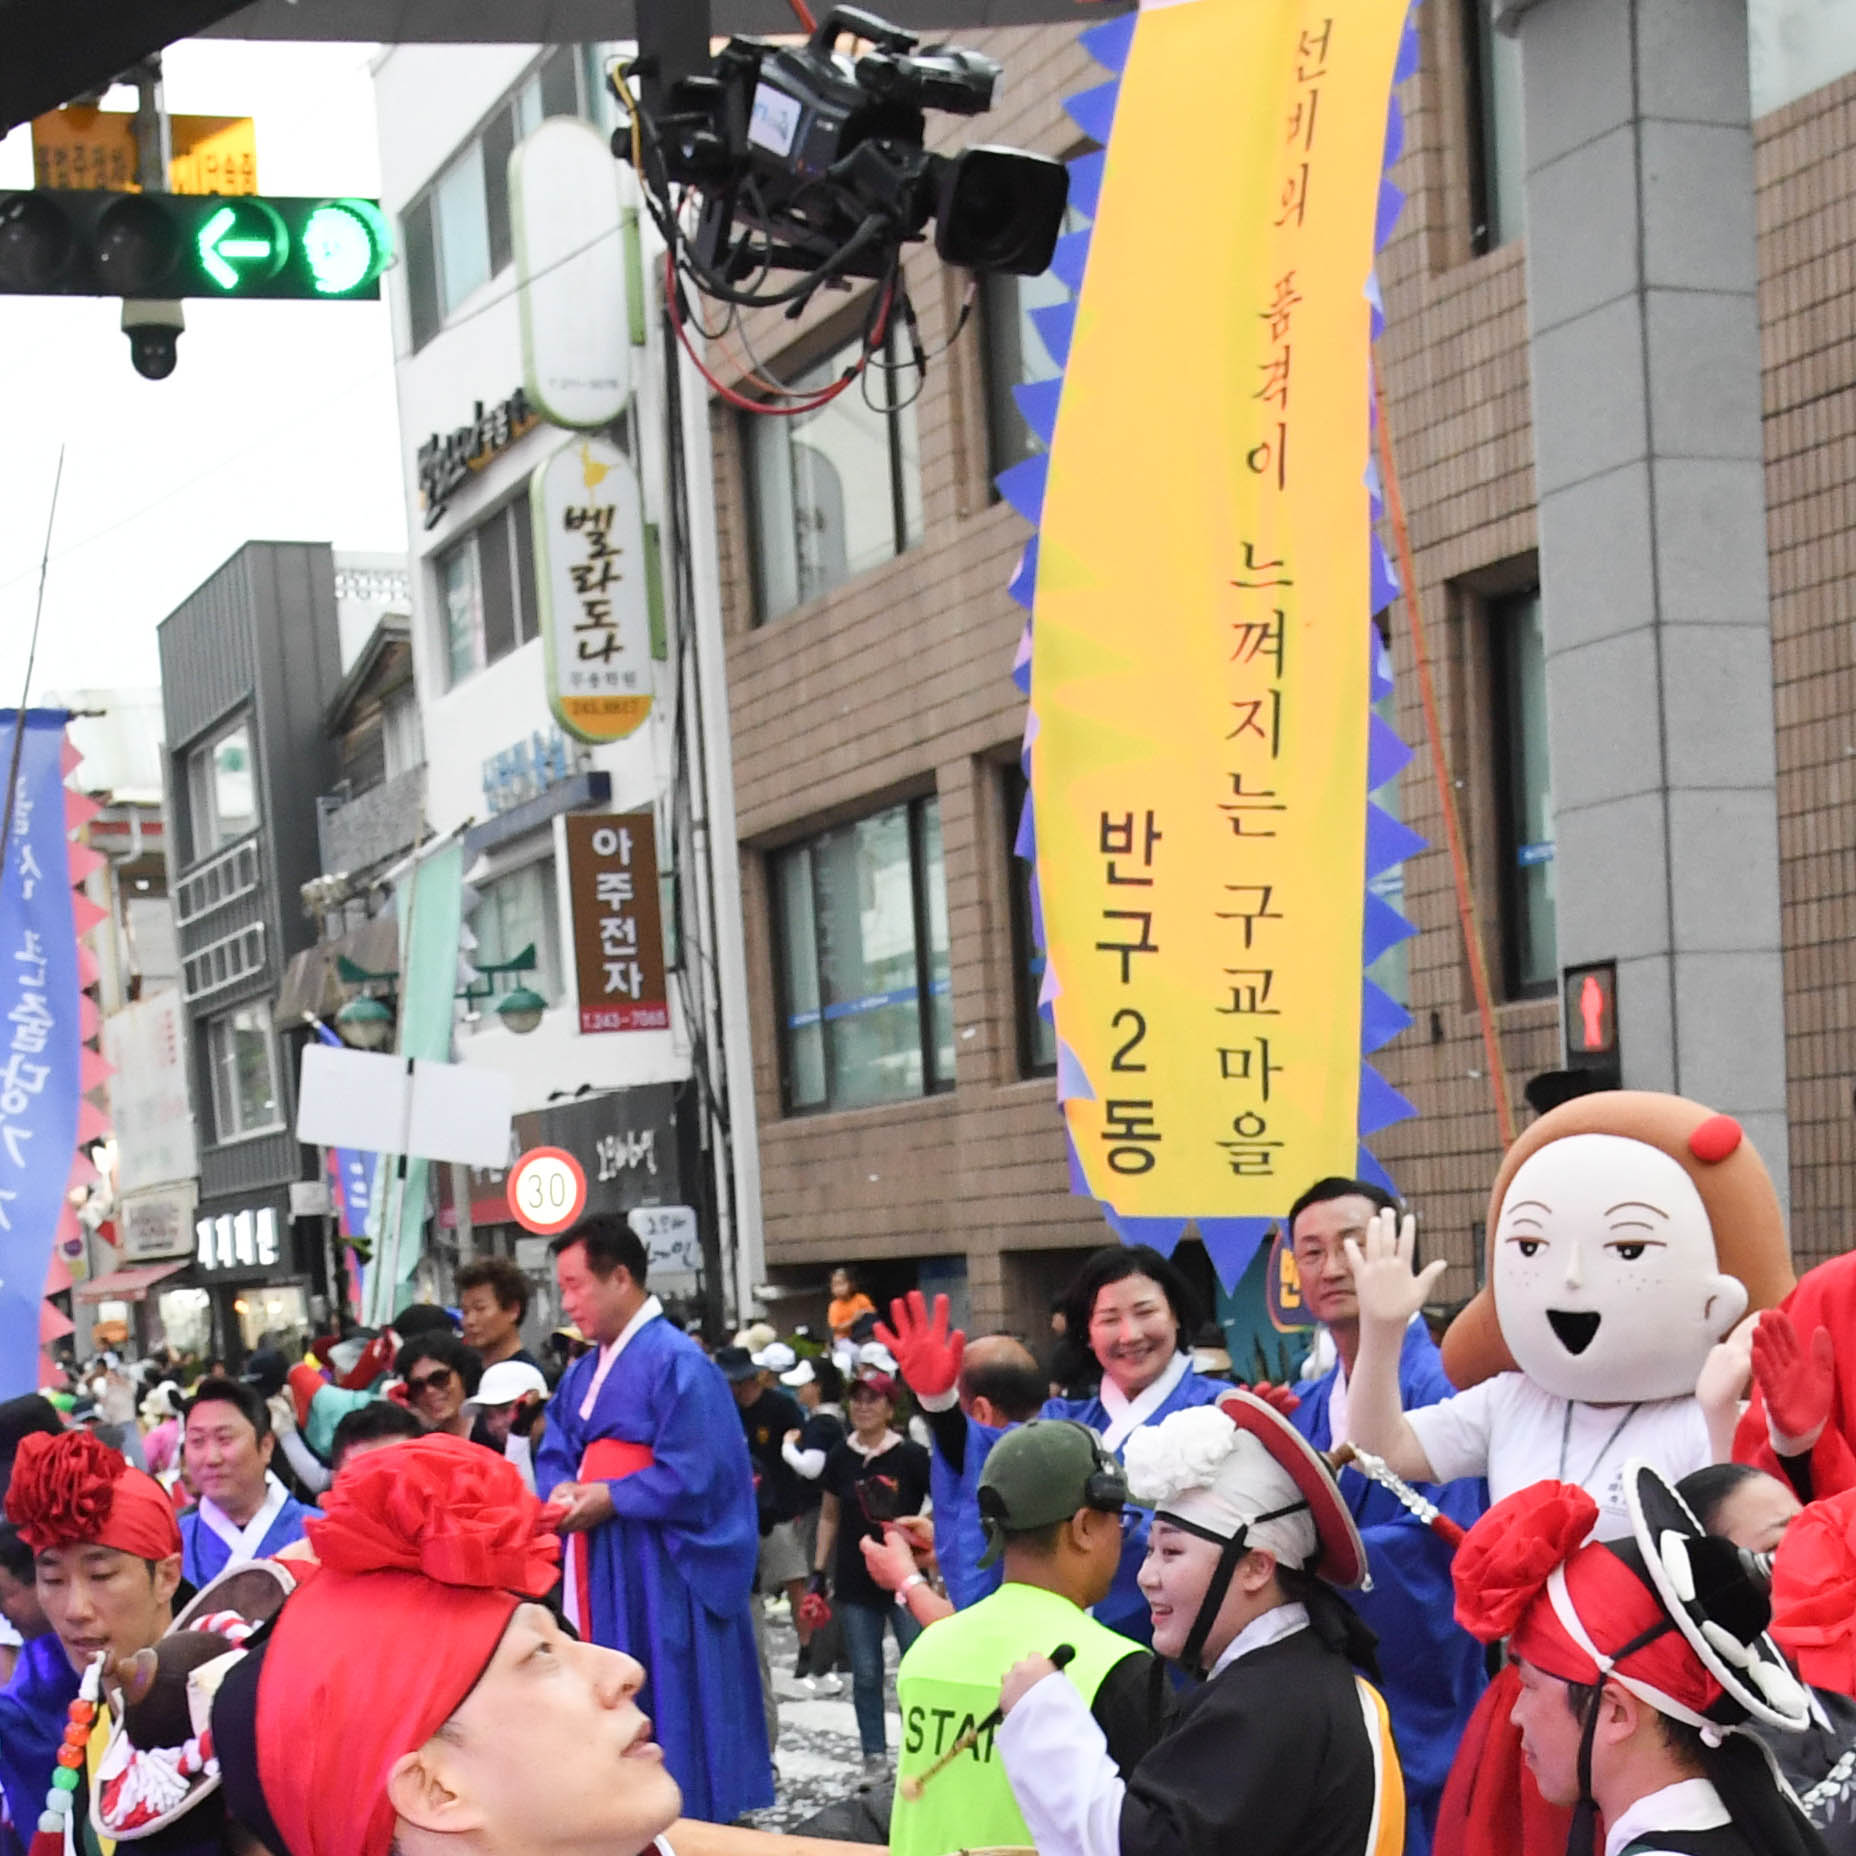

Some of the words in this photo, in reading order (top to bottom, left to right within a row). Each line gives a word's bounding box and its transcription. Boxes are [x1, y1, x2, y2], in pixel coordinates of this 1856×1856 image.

[1272, 18, 1333, 228] 선비의
[1244, 270, 1303, 491] 품격이
[563, 505, 624, 664] 벨라도나
[1216, 541, 1294, 838] 느껴지는
[591, 827, 644, 1000] 아주전자
[1094, 809, 1163, 1176] 반구2동
[528, 1173, 566, 1209] 30
